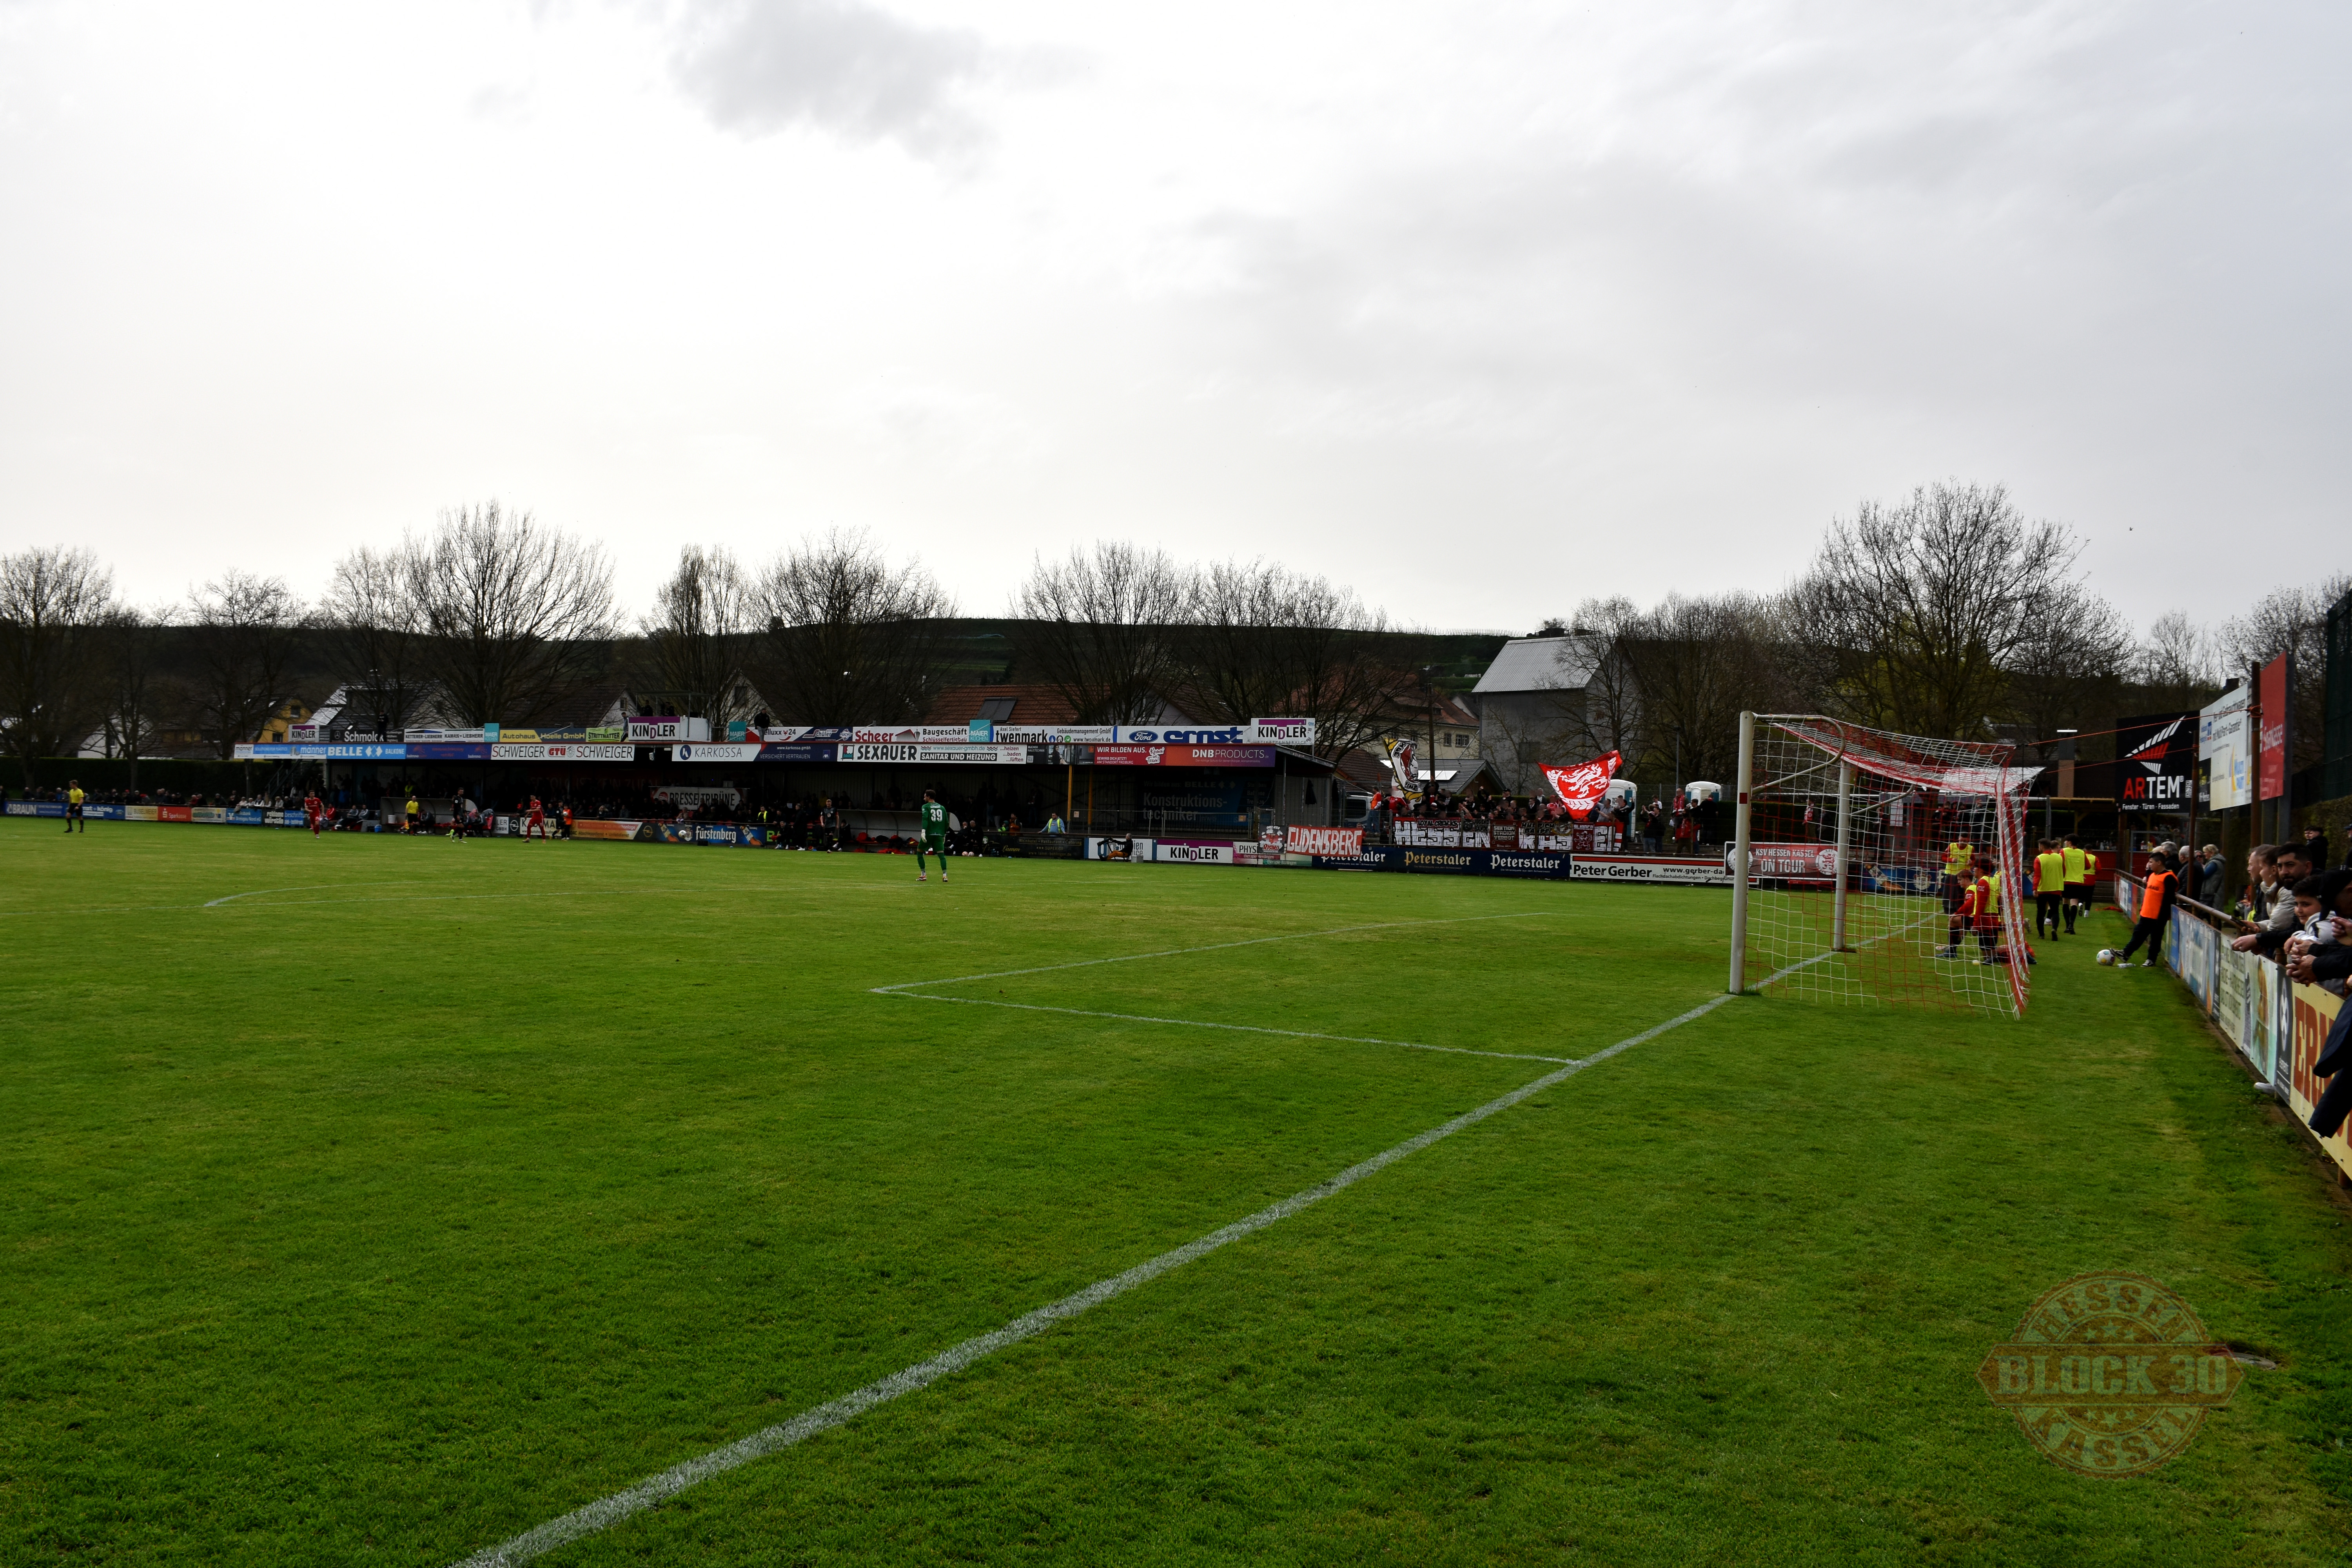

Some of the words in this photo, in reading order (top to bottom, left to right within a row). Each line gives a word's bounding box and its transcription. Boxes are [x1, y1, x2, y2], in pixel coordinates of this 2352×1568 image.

[292, 731, 315, 739] KINDLER
[632, 725, 675, 739] KINDLER
[855, 730, 894, 742] Scheer
[923, 728, 967, 737] Baugeschäft
[996, 730, 1048, 742] twenmark
[1134, 732, 1152, 740] Ford
[1163, 727, 1243, 743] ernst
[1258, 726, 1307, 739] KINDLER
[300, 745, 326, 753] männer
[328, 747, 363, 756] BELLE
[492, 746, 545, 758] SCHWEIGER
[548, 746, 566, 756] GTÜ
[576, 746, 632, 759] SCHWEIGER
[695, 748, 742, 757] KARKOSSA
[857, 745, 917, 760] SEXAUER
[1143, 792, 1227, 808] Konstruktions-
[15, 804, 37, 815] BRAUN
[931, 809, 942, 822] 39
[1143, 807, 1198, 821] techniker
[1287, 826, 1361, 856] GUDENSBERG
[1171, 847, 1218, 861] KINDLER
[1405, 851, 1471, 866] Peterstaler
[1792, 849, 1815, 858] KASSEL
[1490, 855, 1560, 869] Peterstaler
[1761, 859, 1775, 872] ON
[1778, 859, 1806, 873] TOUR
[1573, 864, 1606, 876] Peter
[1608, 866, 1652, 878] Gerber
